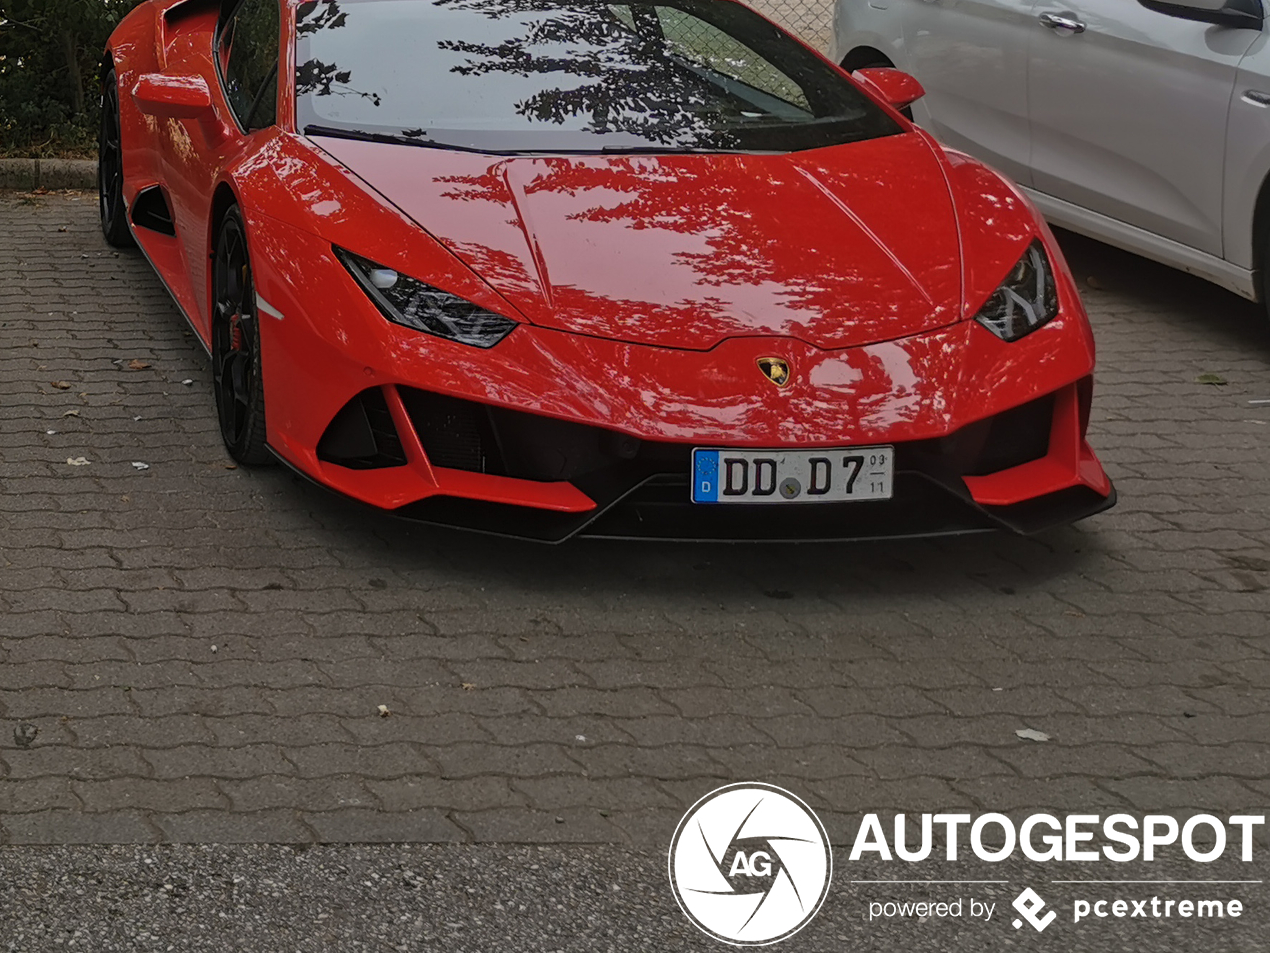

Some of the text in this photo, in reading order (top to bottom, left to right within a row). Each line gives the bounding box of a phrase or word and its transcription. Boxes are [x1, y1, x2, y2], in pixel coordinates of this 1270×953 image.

[723, 458, 777, 496] DD
[701, 481, 711, 492] D
[870, 482, 884, 493] 11
